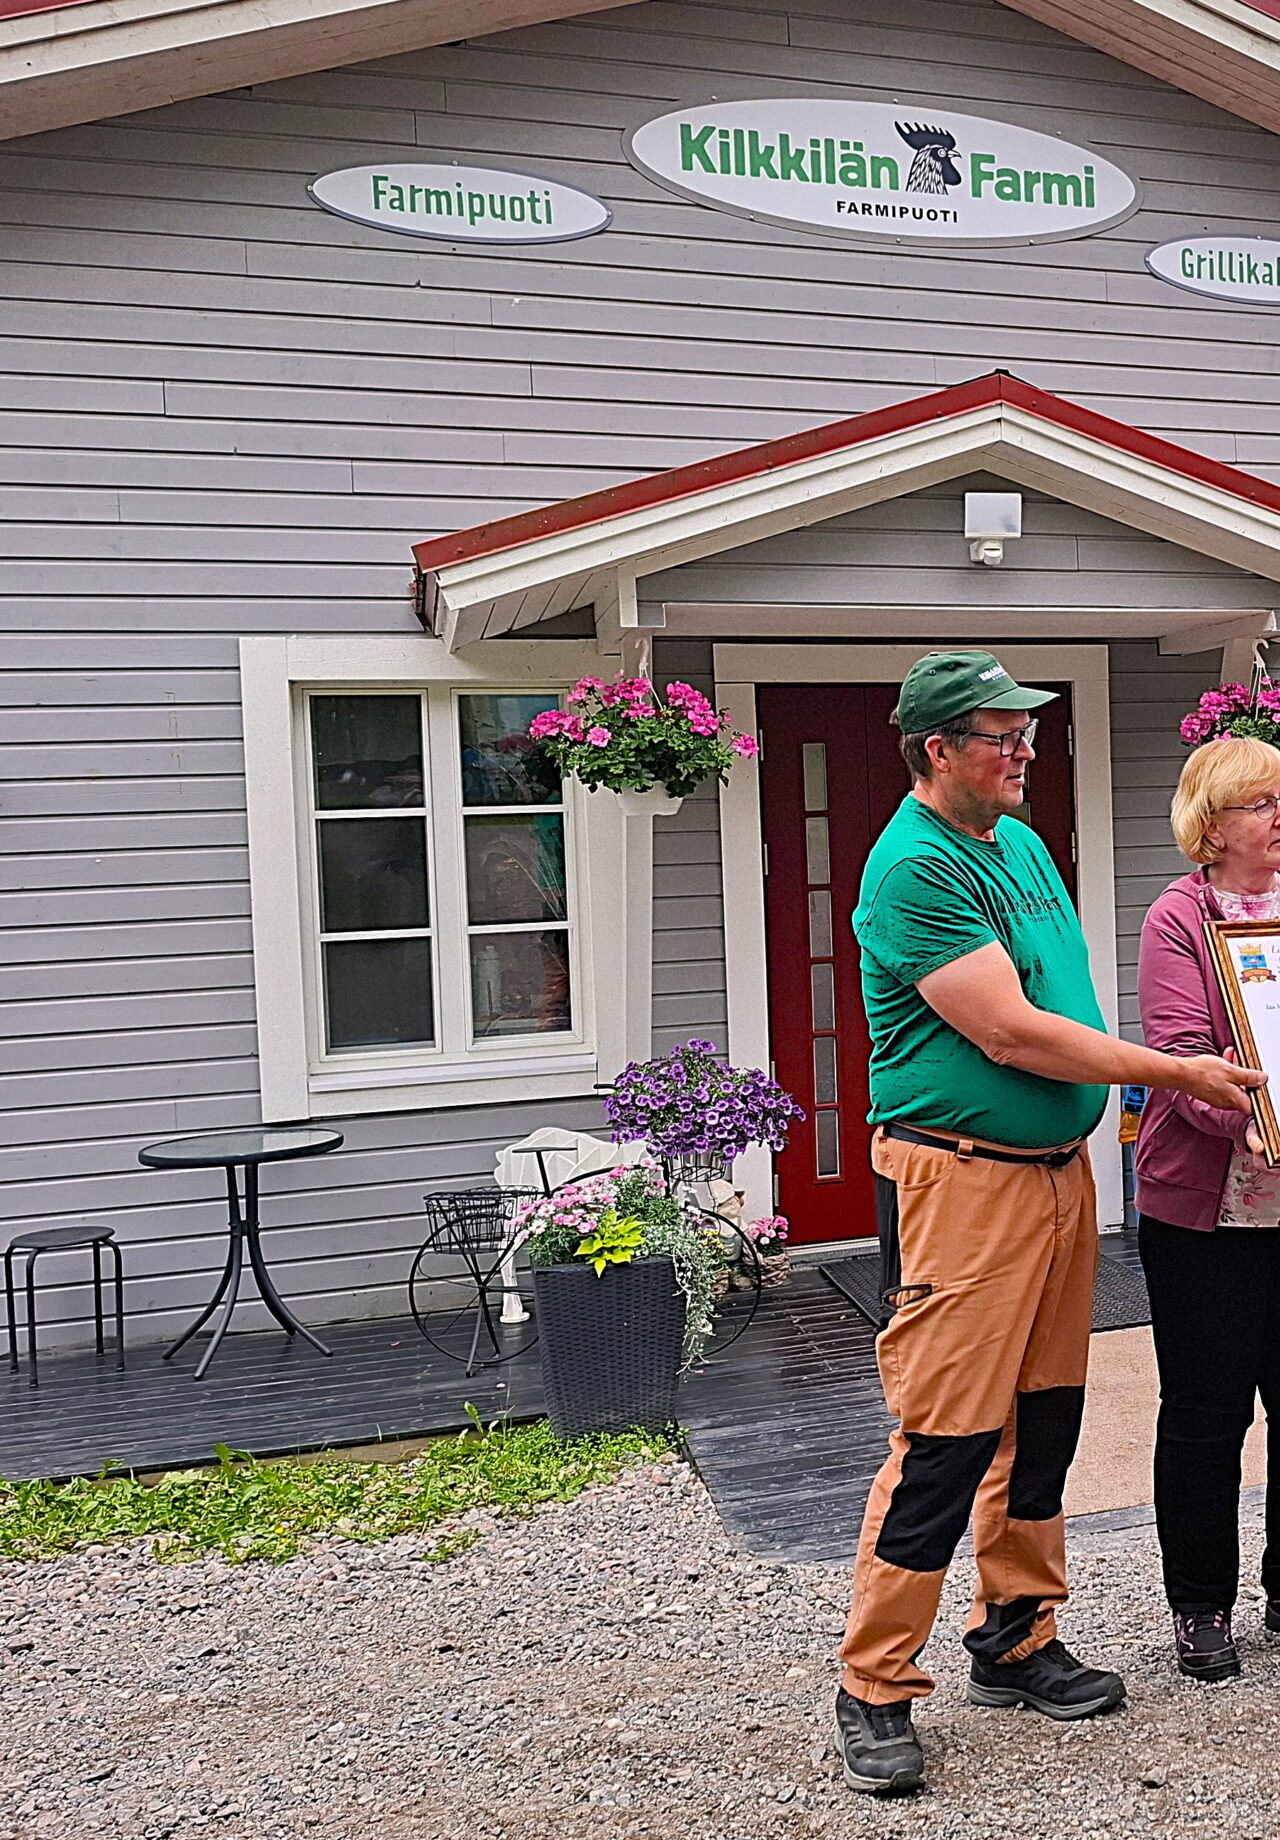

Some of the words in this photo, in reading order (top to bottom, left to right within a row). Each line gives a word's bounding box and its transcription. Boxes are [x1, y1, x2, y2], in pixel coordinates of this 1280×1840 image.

[681, 123, 900, 191] Kilkkilän
[971, 153, 1096, 209] Farmi
[372, 175, 553, 226] Farmipuoti
[836, 200, 959, 223] FARMIPUOTI
